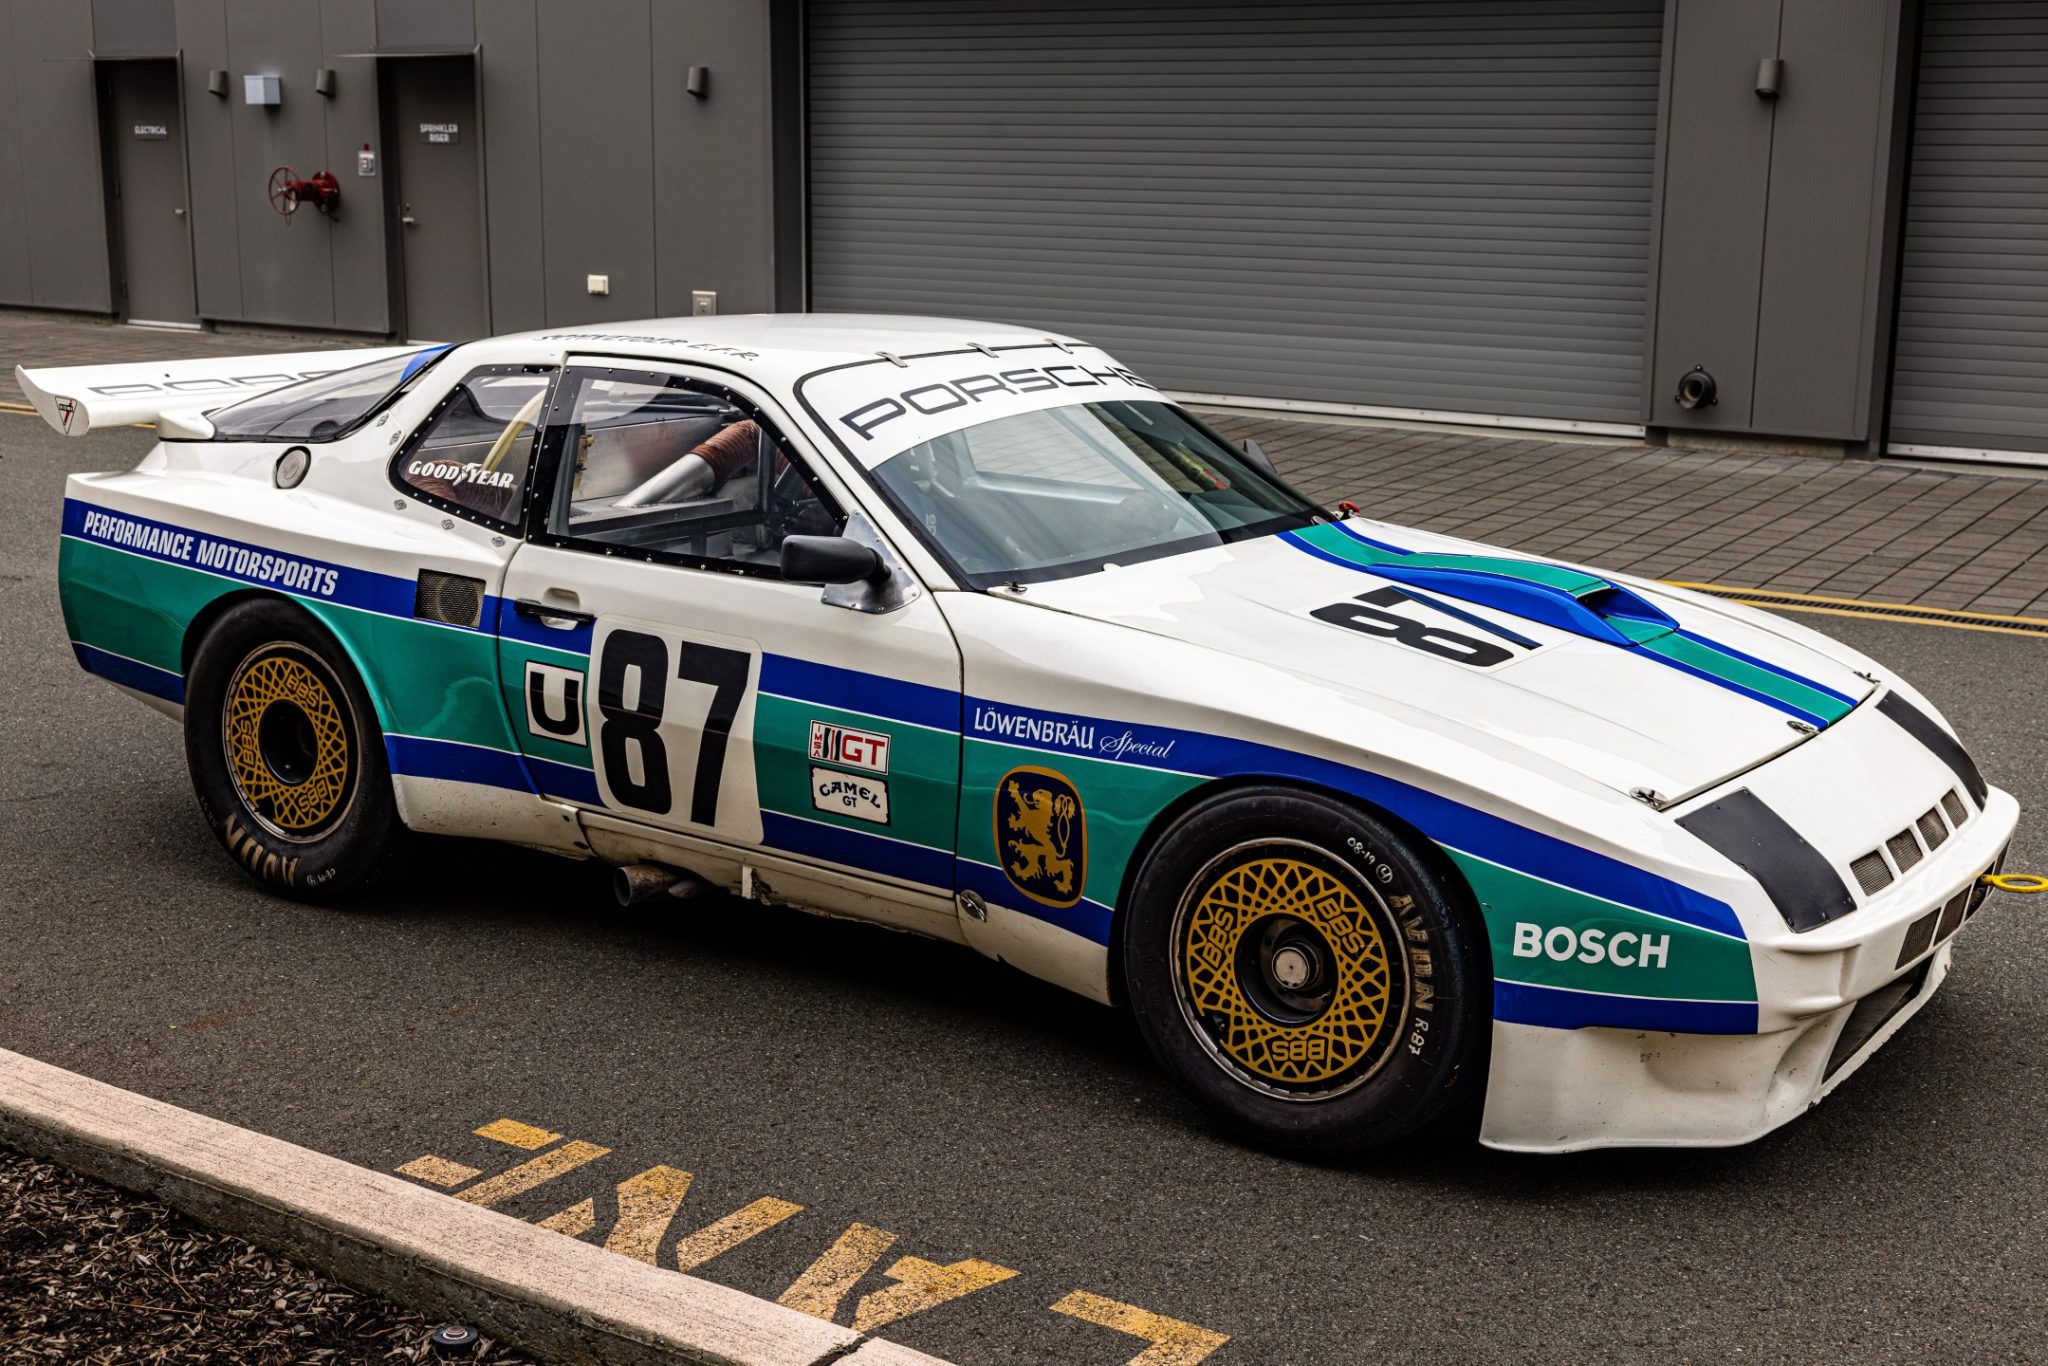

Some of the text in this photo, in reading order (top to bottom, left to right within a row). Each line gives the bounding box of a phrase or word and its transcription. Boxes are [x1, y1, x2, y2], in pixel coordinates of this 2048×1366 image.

[420, 123, 459, 133] SPRINKLER
[429, 133, 449, 142] RISER
[839, 365, 1158, 441] PORSCHE
[83, 510, 339, 596] PERFORMANCE MOTORSPORTS
[1309, 585, 1544, 667] 87
[286, 674, 320, 708] BBS
[529, 671, 580, 736] U
[598, 629, 752, 827] 87
[813, 725, 823, 757] IMSA
[841, 734, 886, 766] GT
[974, 707, 1176, 760] LÖWENBRÄU Special
[819, 781, 881, 809] CAMEL
[842, 796, 857, 808] GT
[1201, 907, 1235, 969] BBS
[1316, 897, 1365, 954] BBS
[1512, 921, 1670, 968] BOSCH
[1271, 1038, 1325, 1061] BBS
